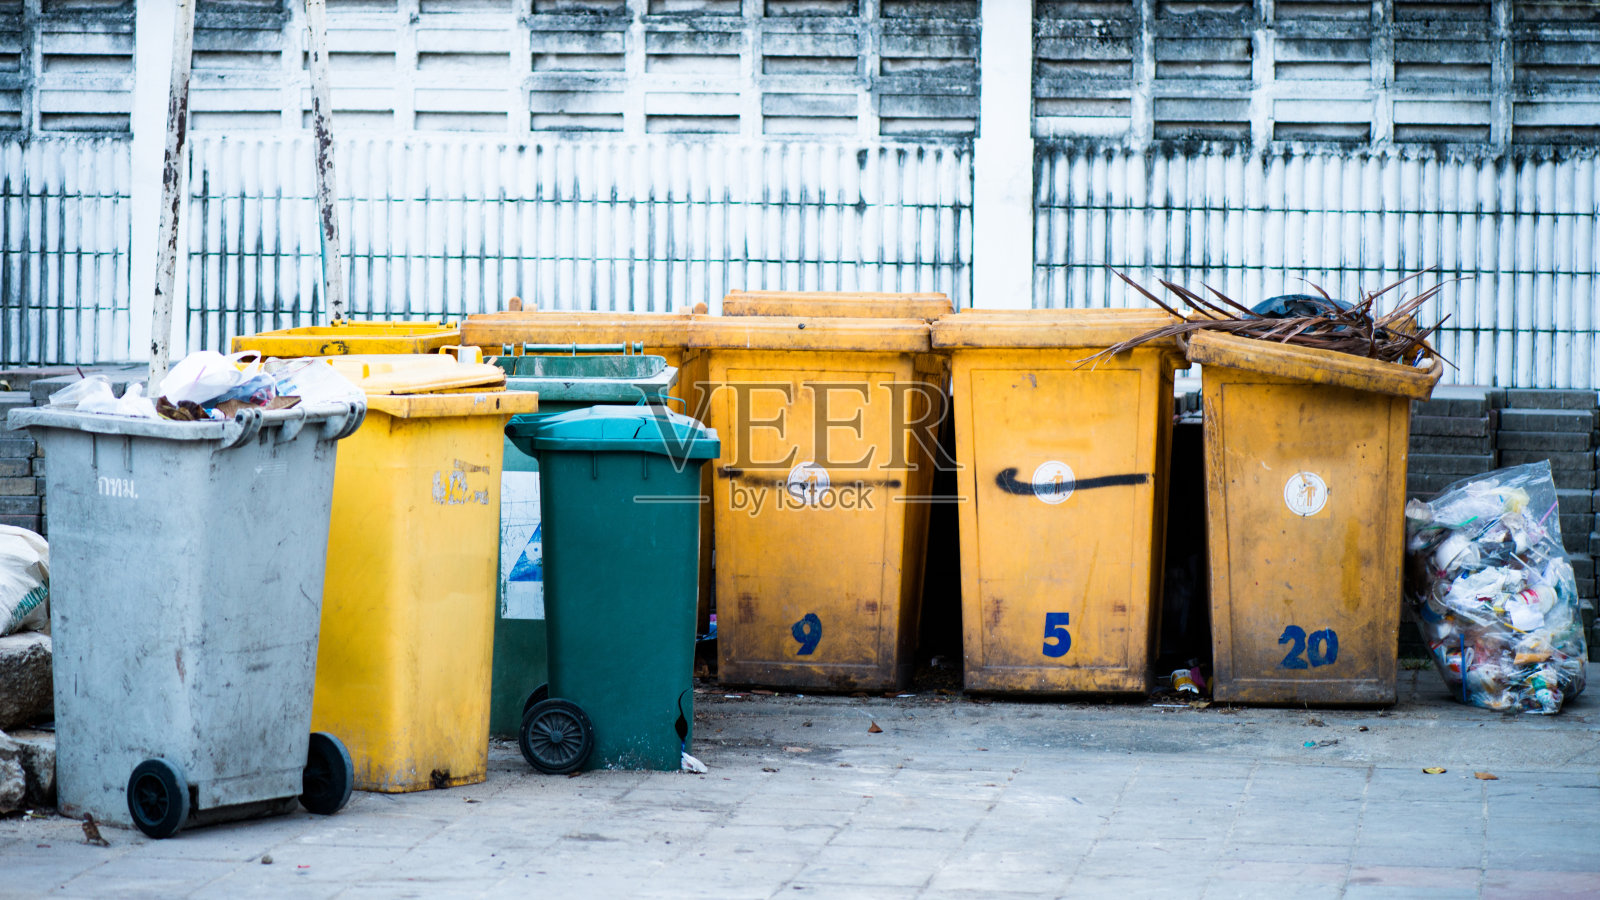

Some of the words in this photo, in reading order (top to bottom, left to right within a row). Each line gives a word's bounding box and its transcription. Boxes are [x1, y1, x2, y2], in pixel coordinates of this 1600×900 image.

[98, 476, 138, 499] กทม.
[791, 612, 823, 656] 9
[1042, 612, 1072, 658] 5
[1278, 624, 1339, 670] 20
